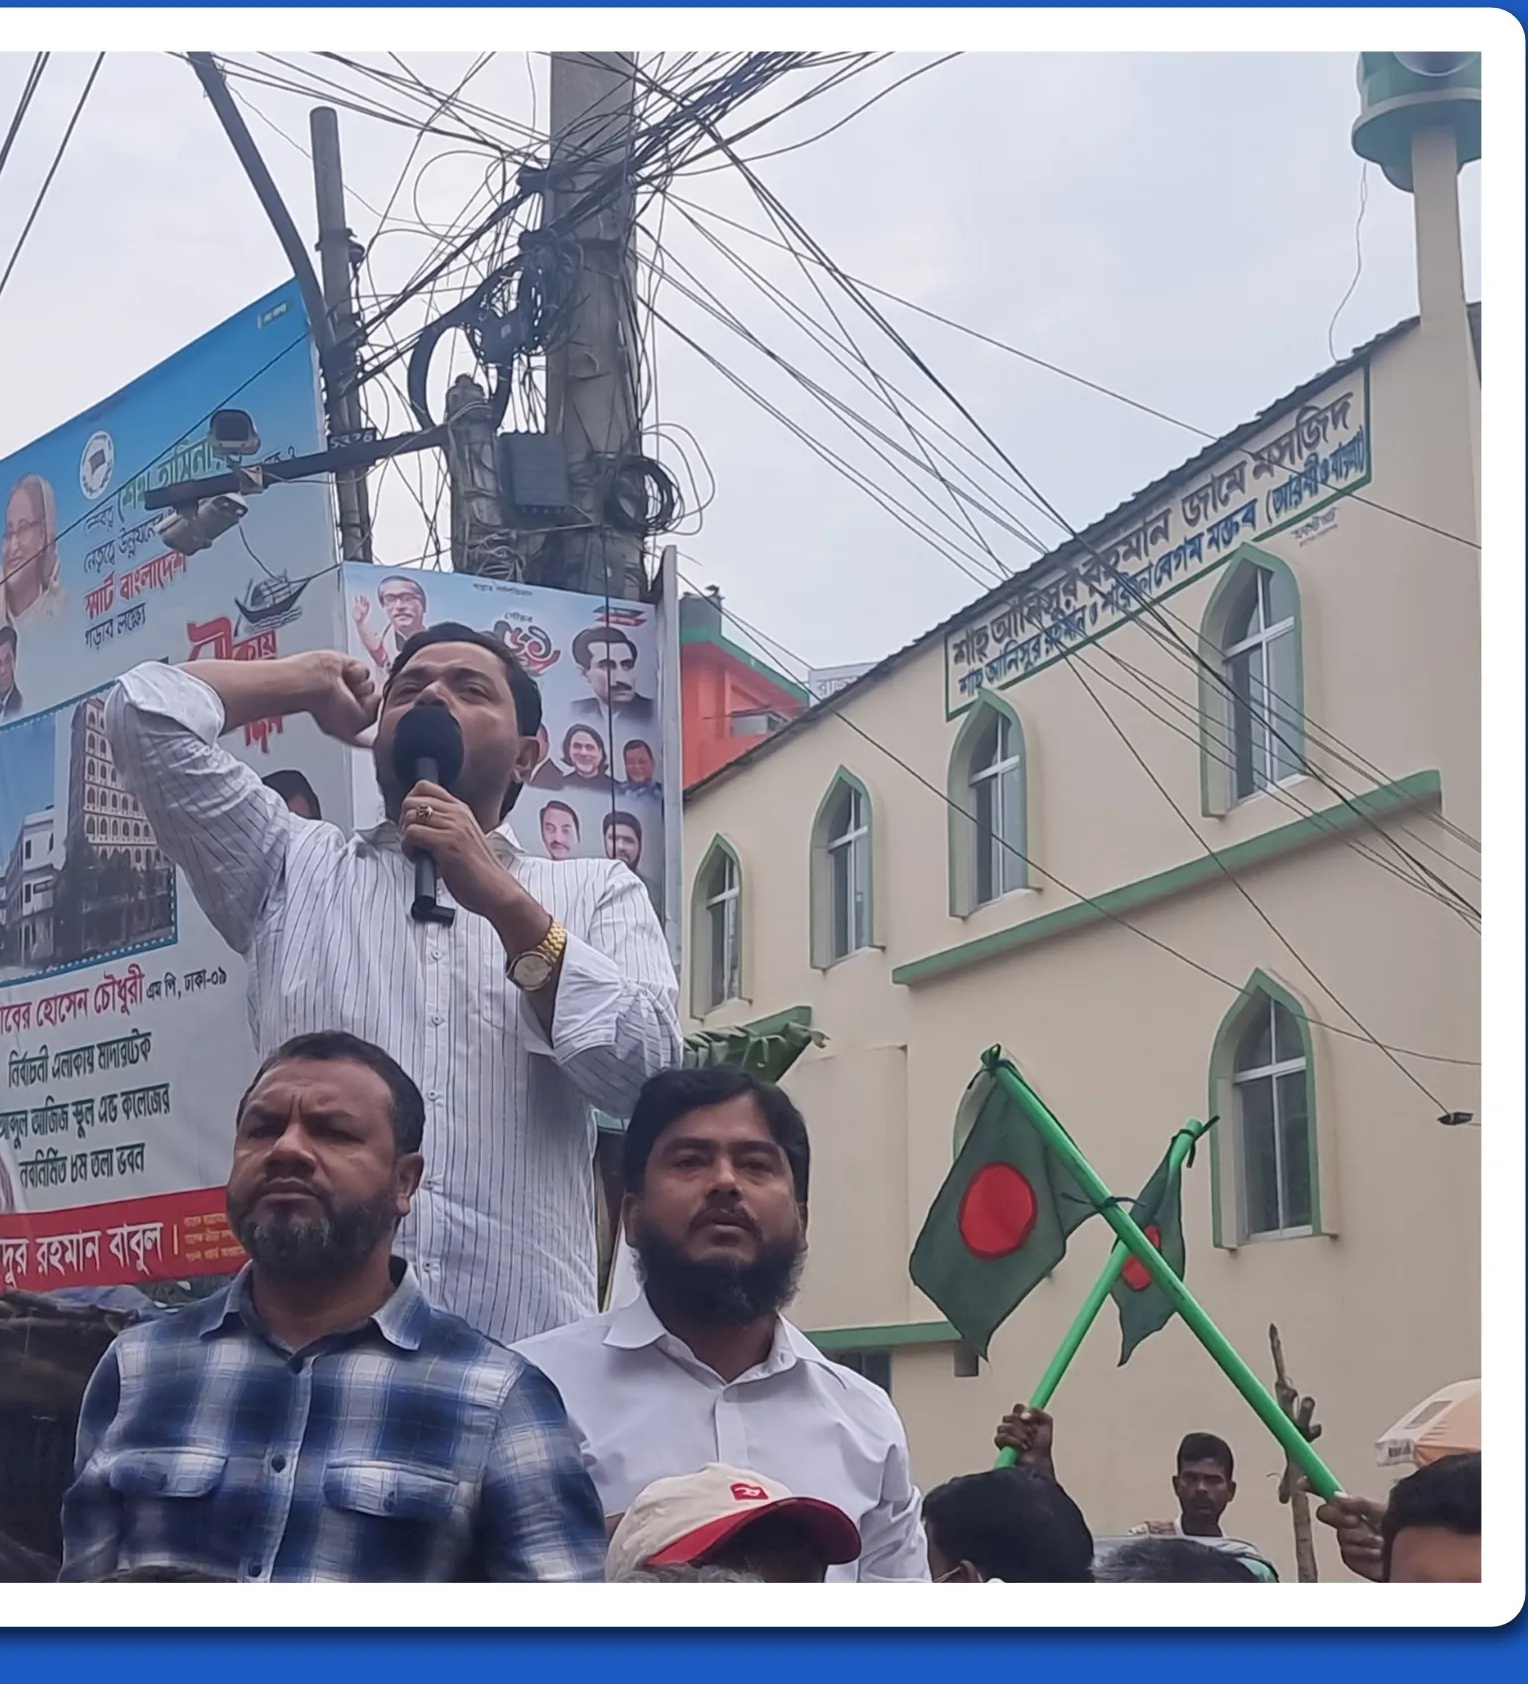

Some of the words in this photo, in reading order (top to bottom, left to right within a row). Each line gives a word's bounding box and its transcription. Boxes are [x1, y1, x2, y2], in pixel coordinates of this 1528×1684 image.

[1252, 391, 1355, 480] মসজিদ
[36, 988, 91, 1030] হোসেন
[93, 963, 145, 1017] চৌধুরী
[36, 1228, 102, 1276] রহমান
[106, 1221, 164, 1276] বাবুল
